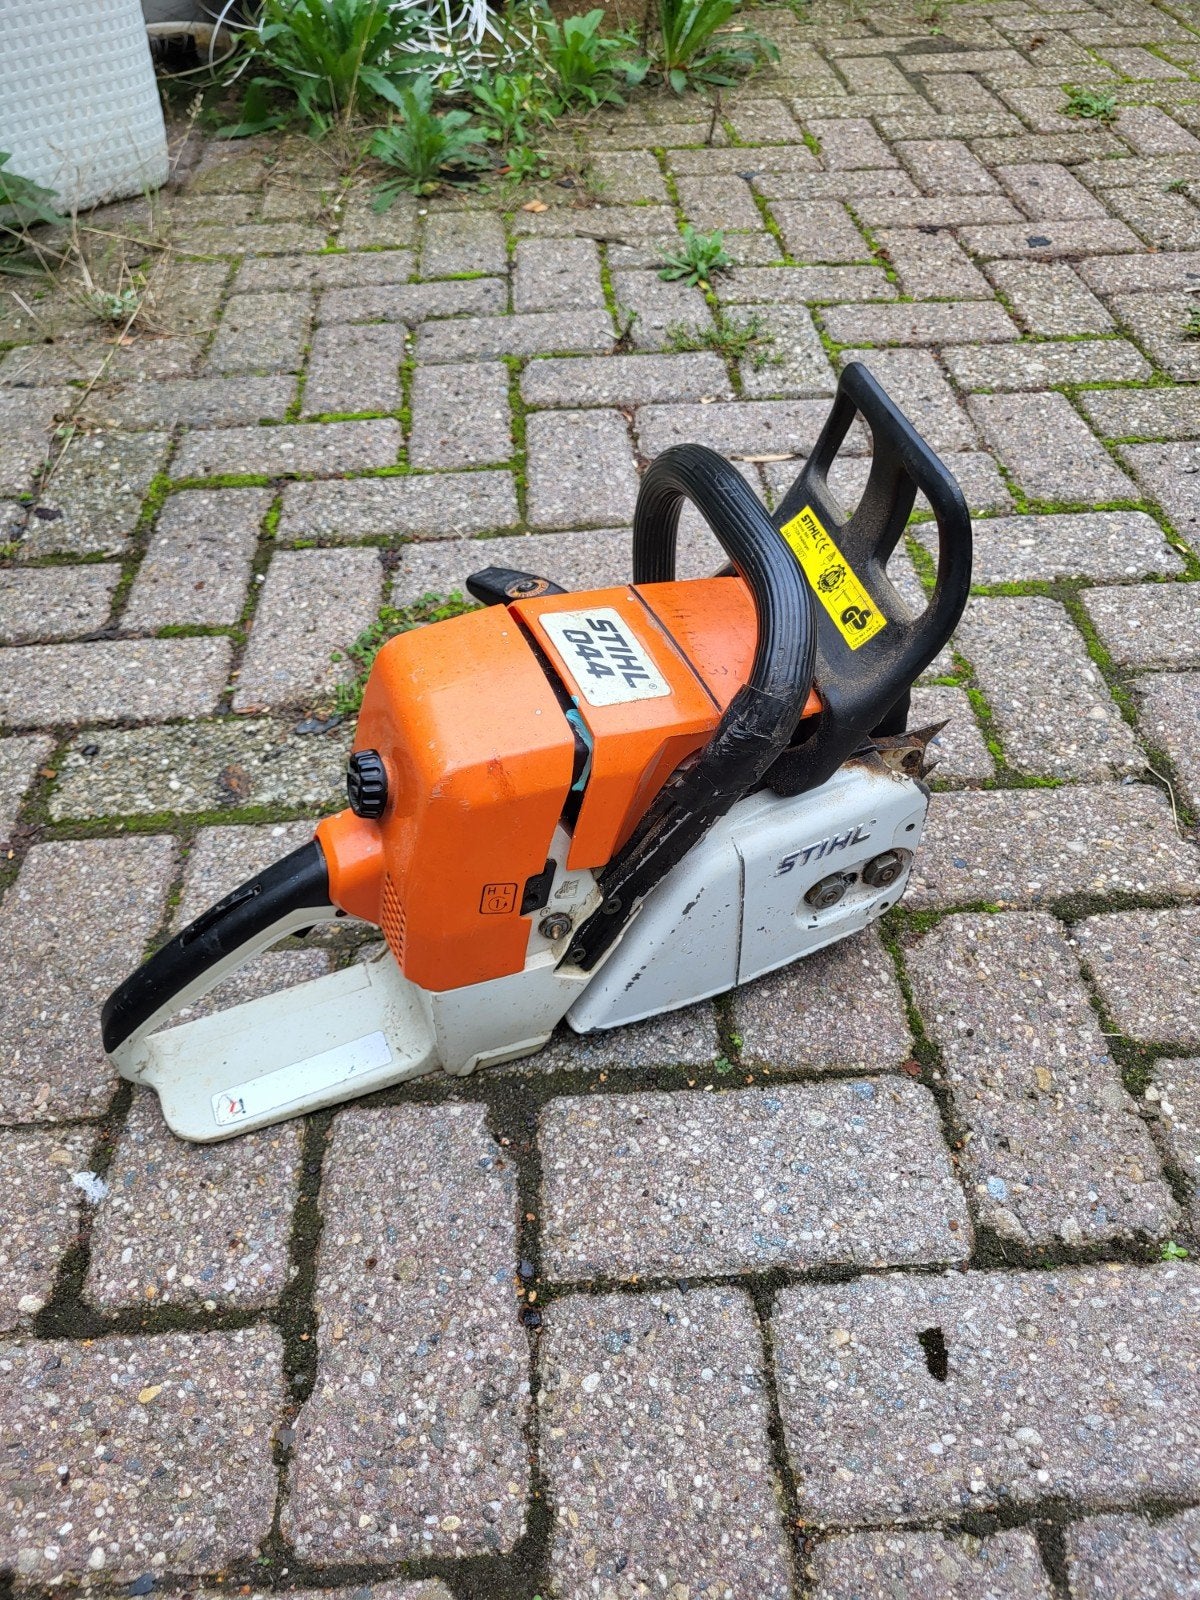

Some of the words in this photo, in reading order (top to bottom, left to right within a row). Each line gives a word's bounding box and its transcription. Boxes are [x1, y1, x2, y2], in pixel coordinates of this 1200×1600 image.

[801, 514, 820, 540] STIHL
[841, 606, 872, 630] GS
[562, 629, 615, 679] 044
[585, 618, 651, 688] STIHL
[775, 823, 871, 878] STIHL
[488, 887, 496, 895] H
[503, 886, 511, 895] L
